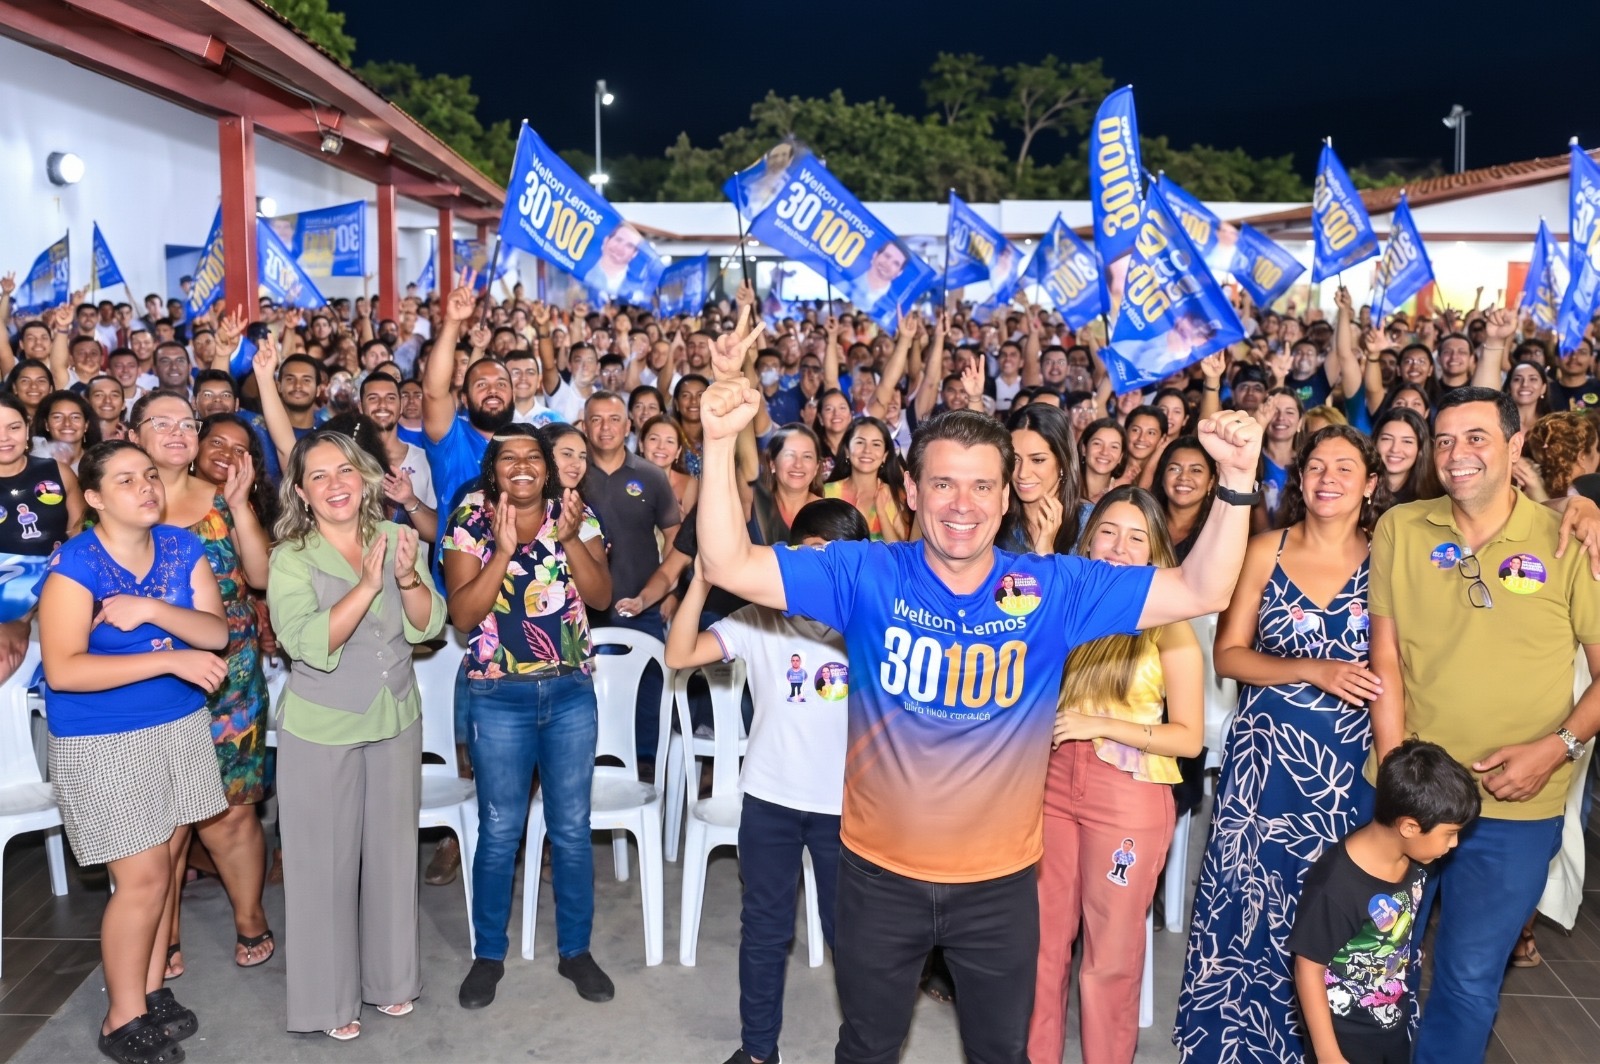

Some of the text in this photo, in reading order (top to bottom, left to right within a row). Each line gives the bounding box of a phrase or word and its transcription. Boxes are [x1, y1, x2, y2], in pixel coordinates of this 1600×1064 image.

[518, 170, 595, 262] 30100
[533, 153, 604, 226] Welton Lemos
[799, 168, 876, 239] Welton Lemos
[1098, 116, 1140, 237] 30100
[776, 181, 866, 268] 30100
[894, 597, 1027, 636] Welton Lemos
[880, 626, 1028, 709] 30100
